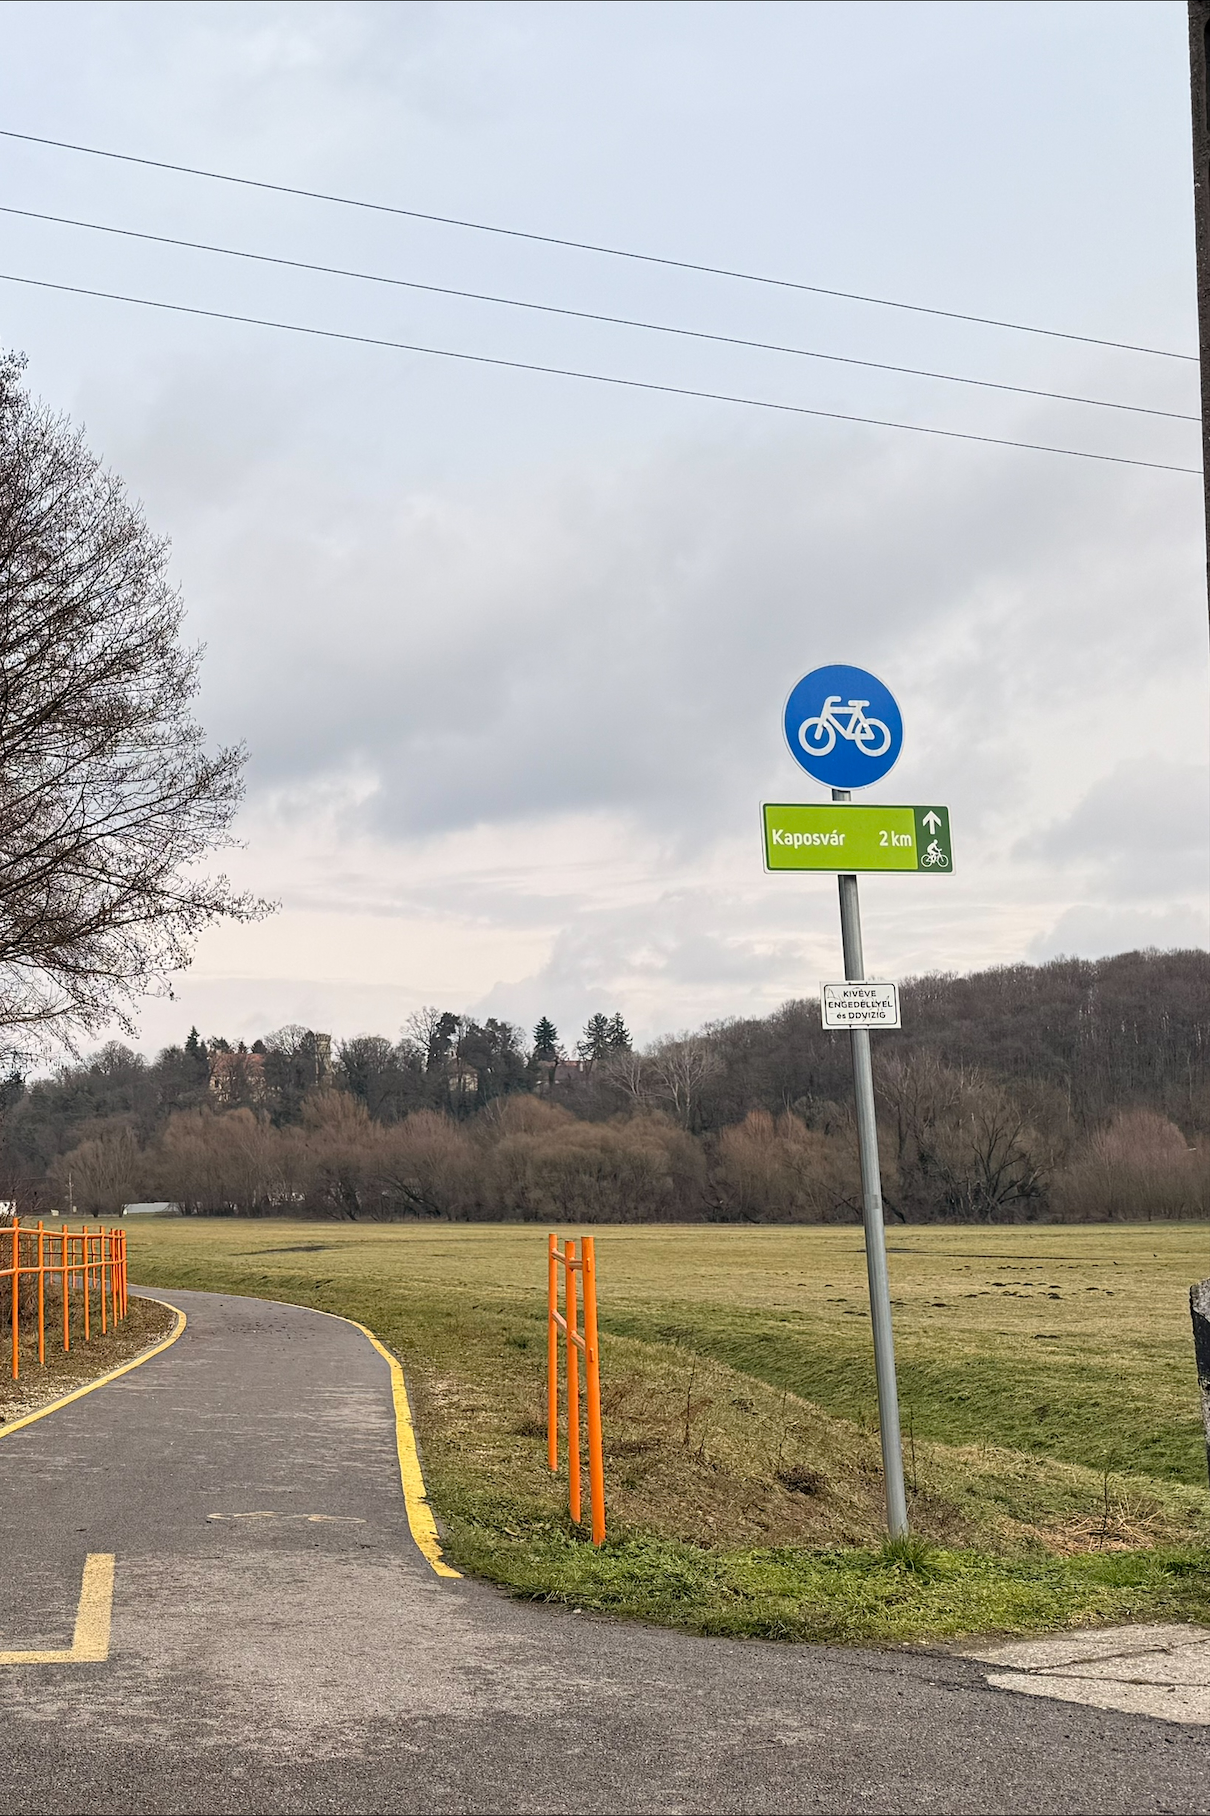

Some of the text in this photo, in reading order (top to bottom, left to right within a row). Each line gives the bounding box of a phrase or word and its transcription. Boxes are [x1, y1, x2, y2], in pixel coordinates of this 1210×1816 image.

[772, 829, 912, 850] Kaposvár 2 km
[843, 989, 876, 998] KIVÉVE
